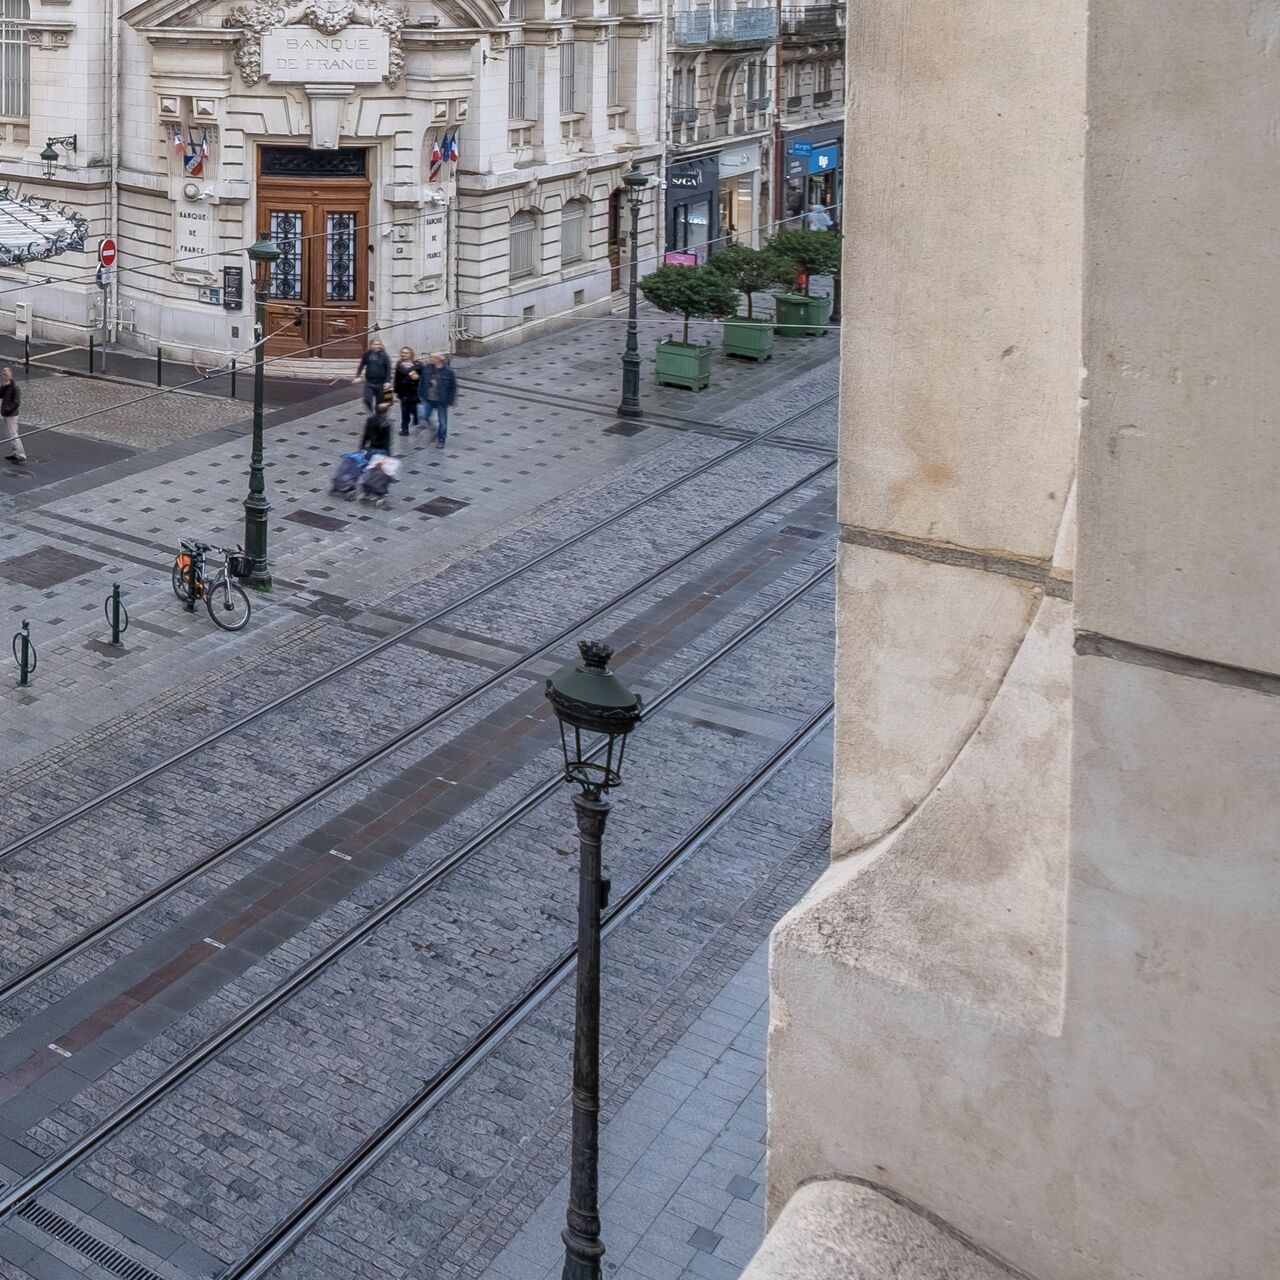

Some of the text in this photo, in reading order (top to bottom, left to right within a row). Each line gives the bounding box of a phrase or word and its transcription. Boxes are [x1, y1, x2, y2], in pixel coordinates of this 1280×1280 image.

[286, 39, 371, 52] BANQUE
[277, 59, 378, 70] DE FRANCE
[180, 211, 207, 221] BANQUE
